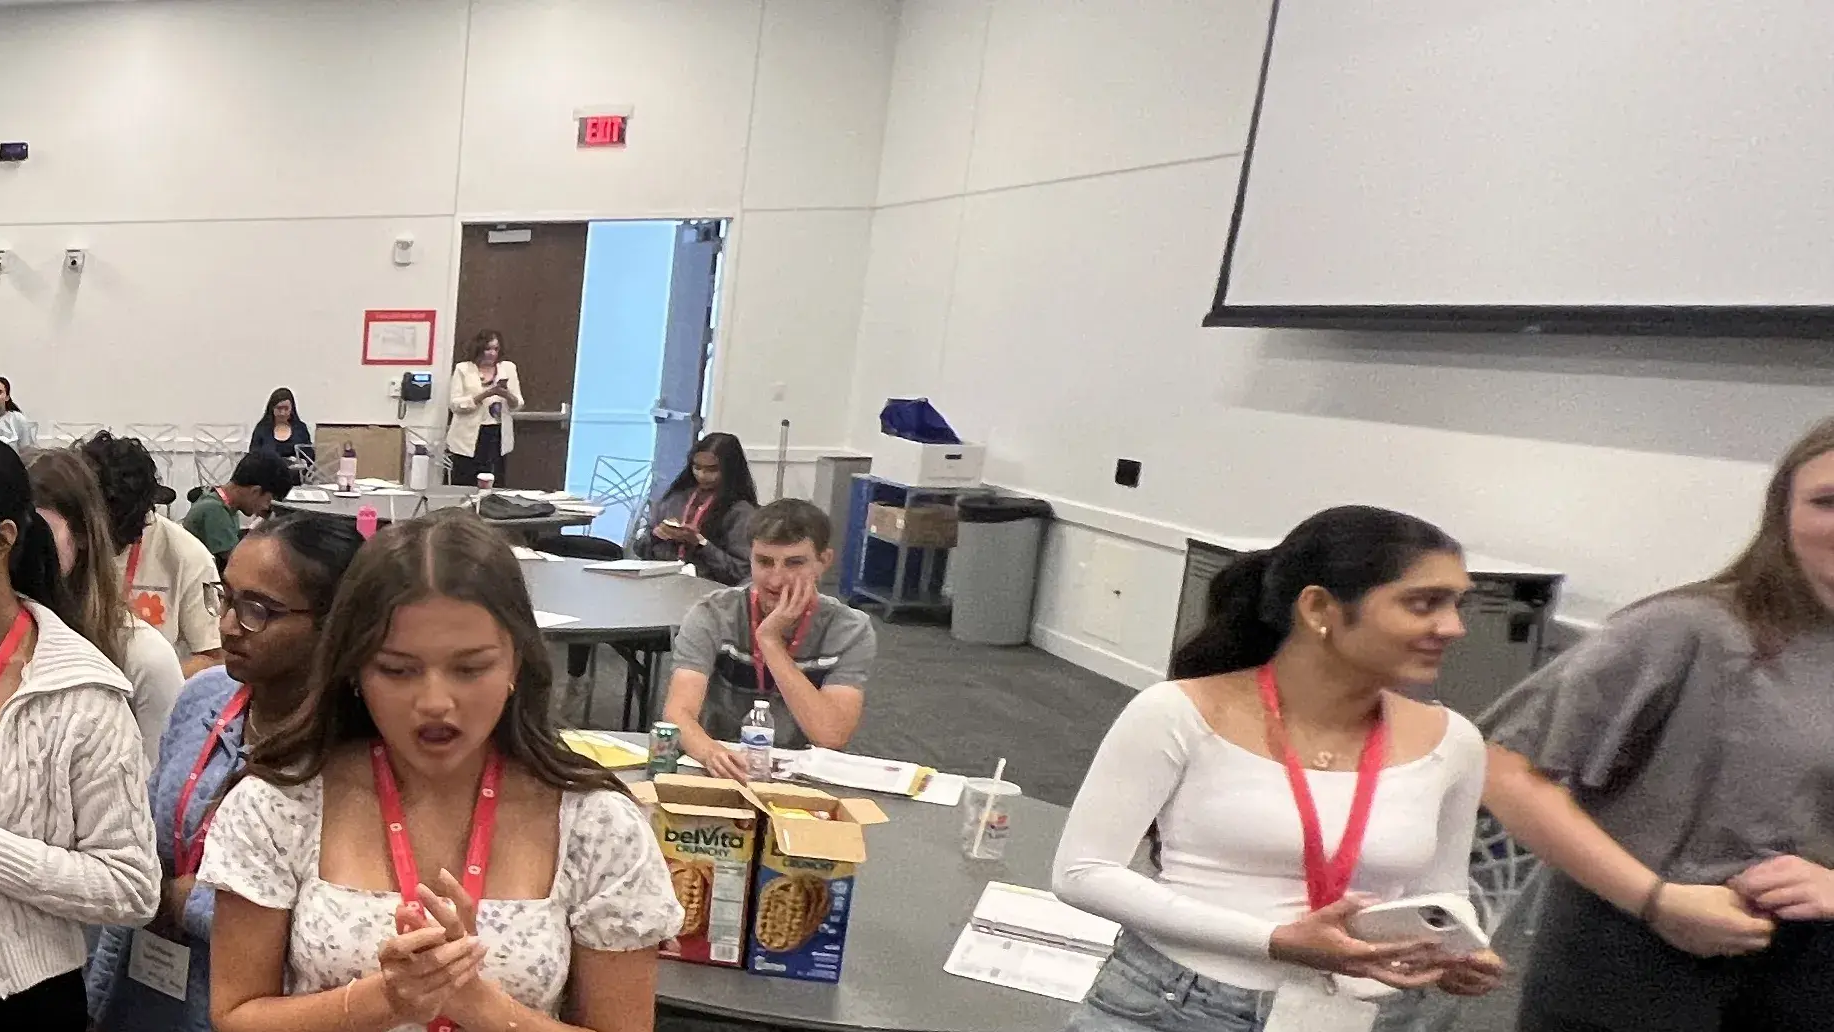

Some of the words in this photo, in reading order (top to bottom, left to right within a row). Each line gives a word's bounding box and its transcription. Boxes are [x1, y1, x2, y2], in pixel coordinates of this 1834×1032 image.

[586, 116, 622, 143] EXIT
[664, 825, 744, 849] belVita
[675, 844, 729, 858] CRUNCHY
